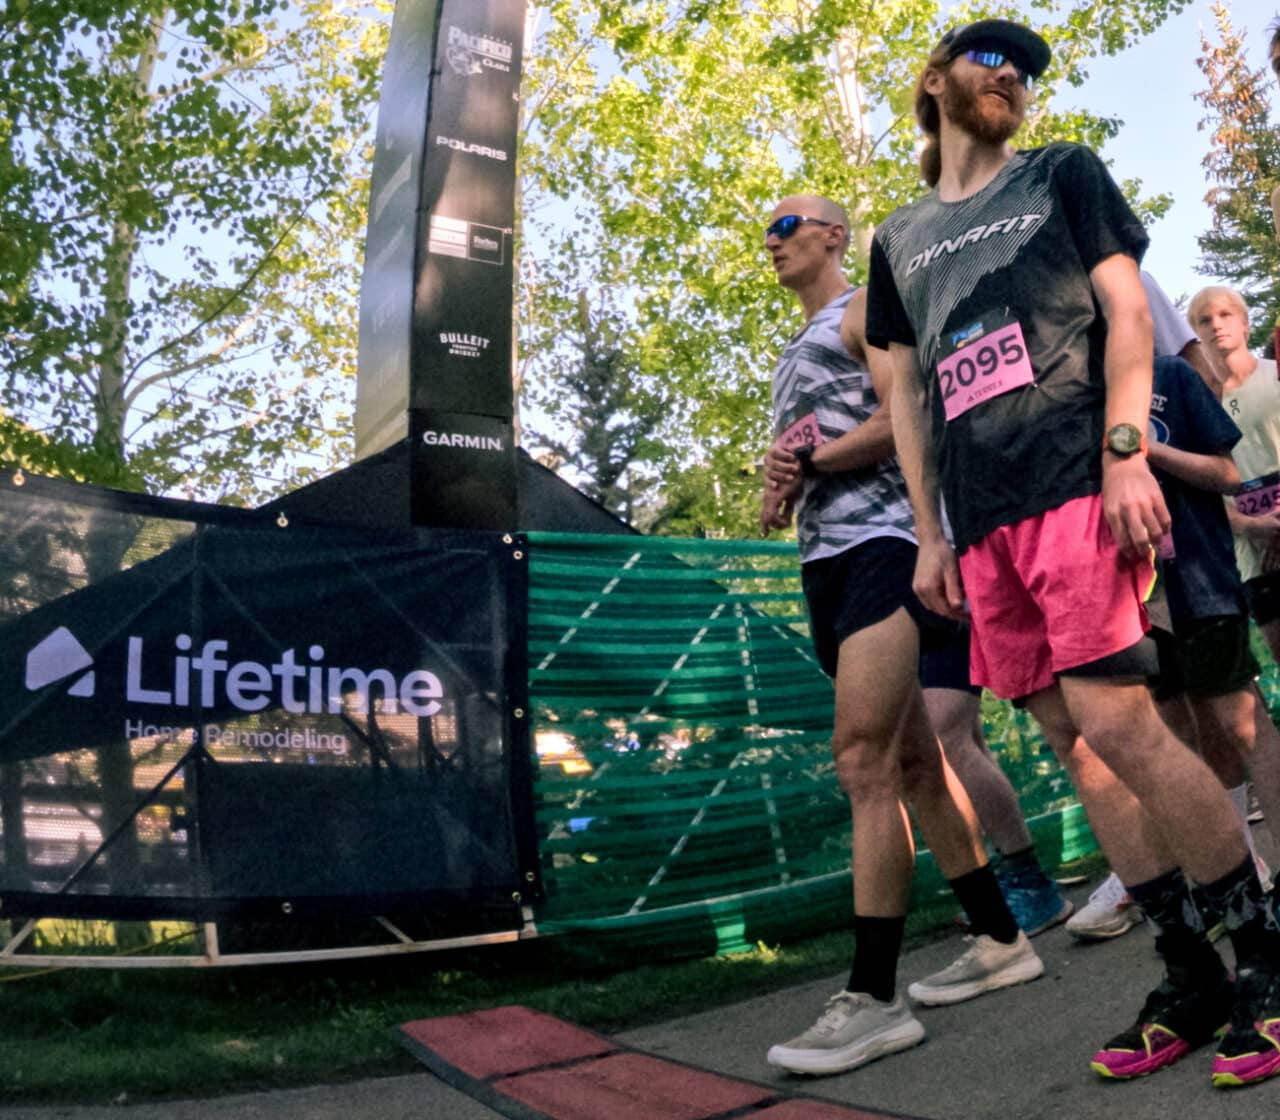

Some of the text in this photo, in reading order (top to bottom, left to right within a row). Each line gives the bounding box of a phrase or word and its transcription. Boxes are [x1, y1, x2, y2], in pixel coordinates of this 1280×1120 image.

[436, 135, 507, 161] POLARIS
[905, 213, 1041, 277] DYNAFIT
[439, 332, 490, 350] BULLEIT
[940, 334, 1024, 402] 2095
[423, 431, 501, 450] GARMIN
[126, 633, 444, 717] Lifetime
[124, 719, 347, 756] Home Remodeling
